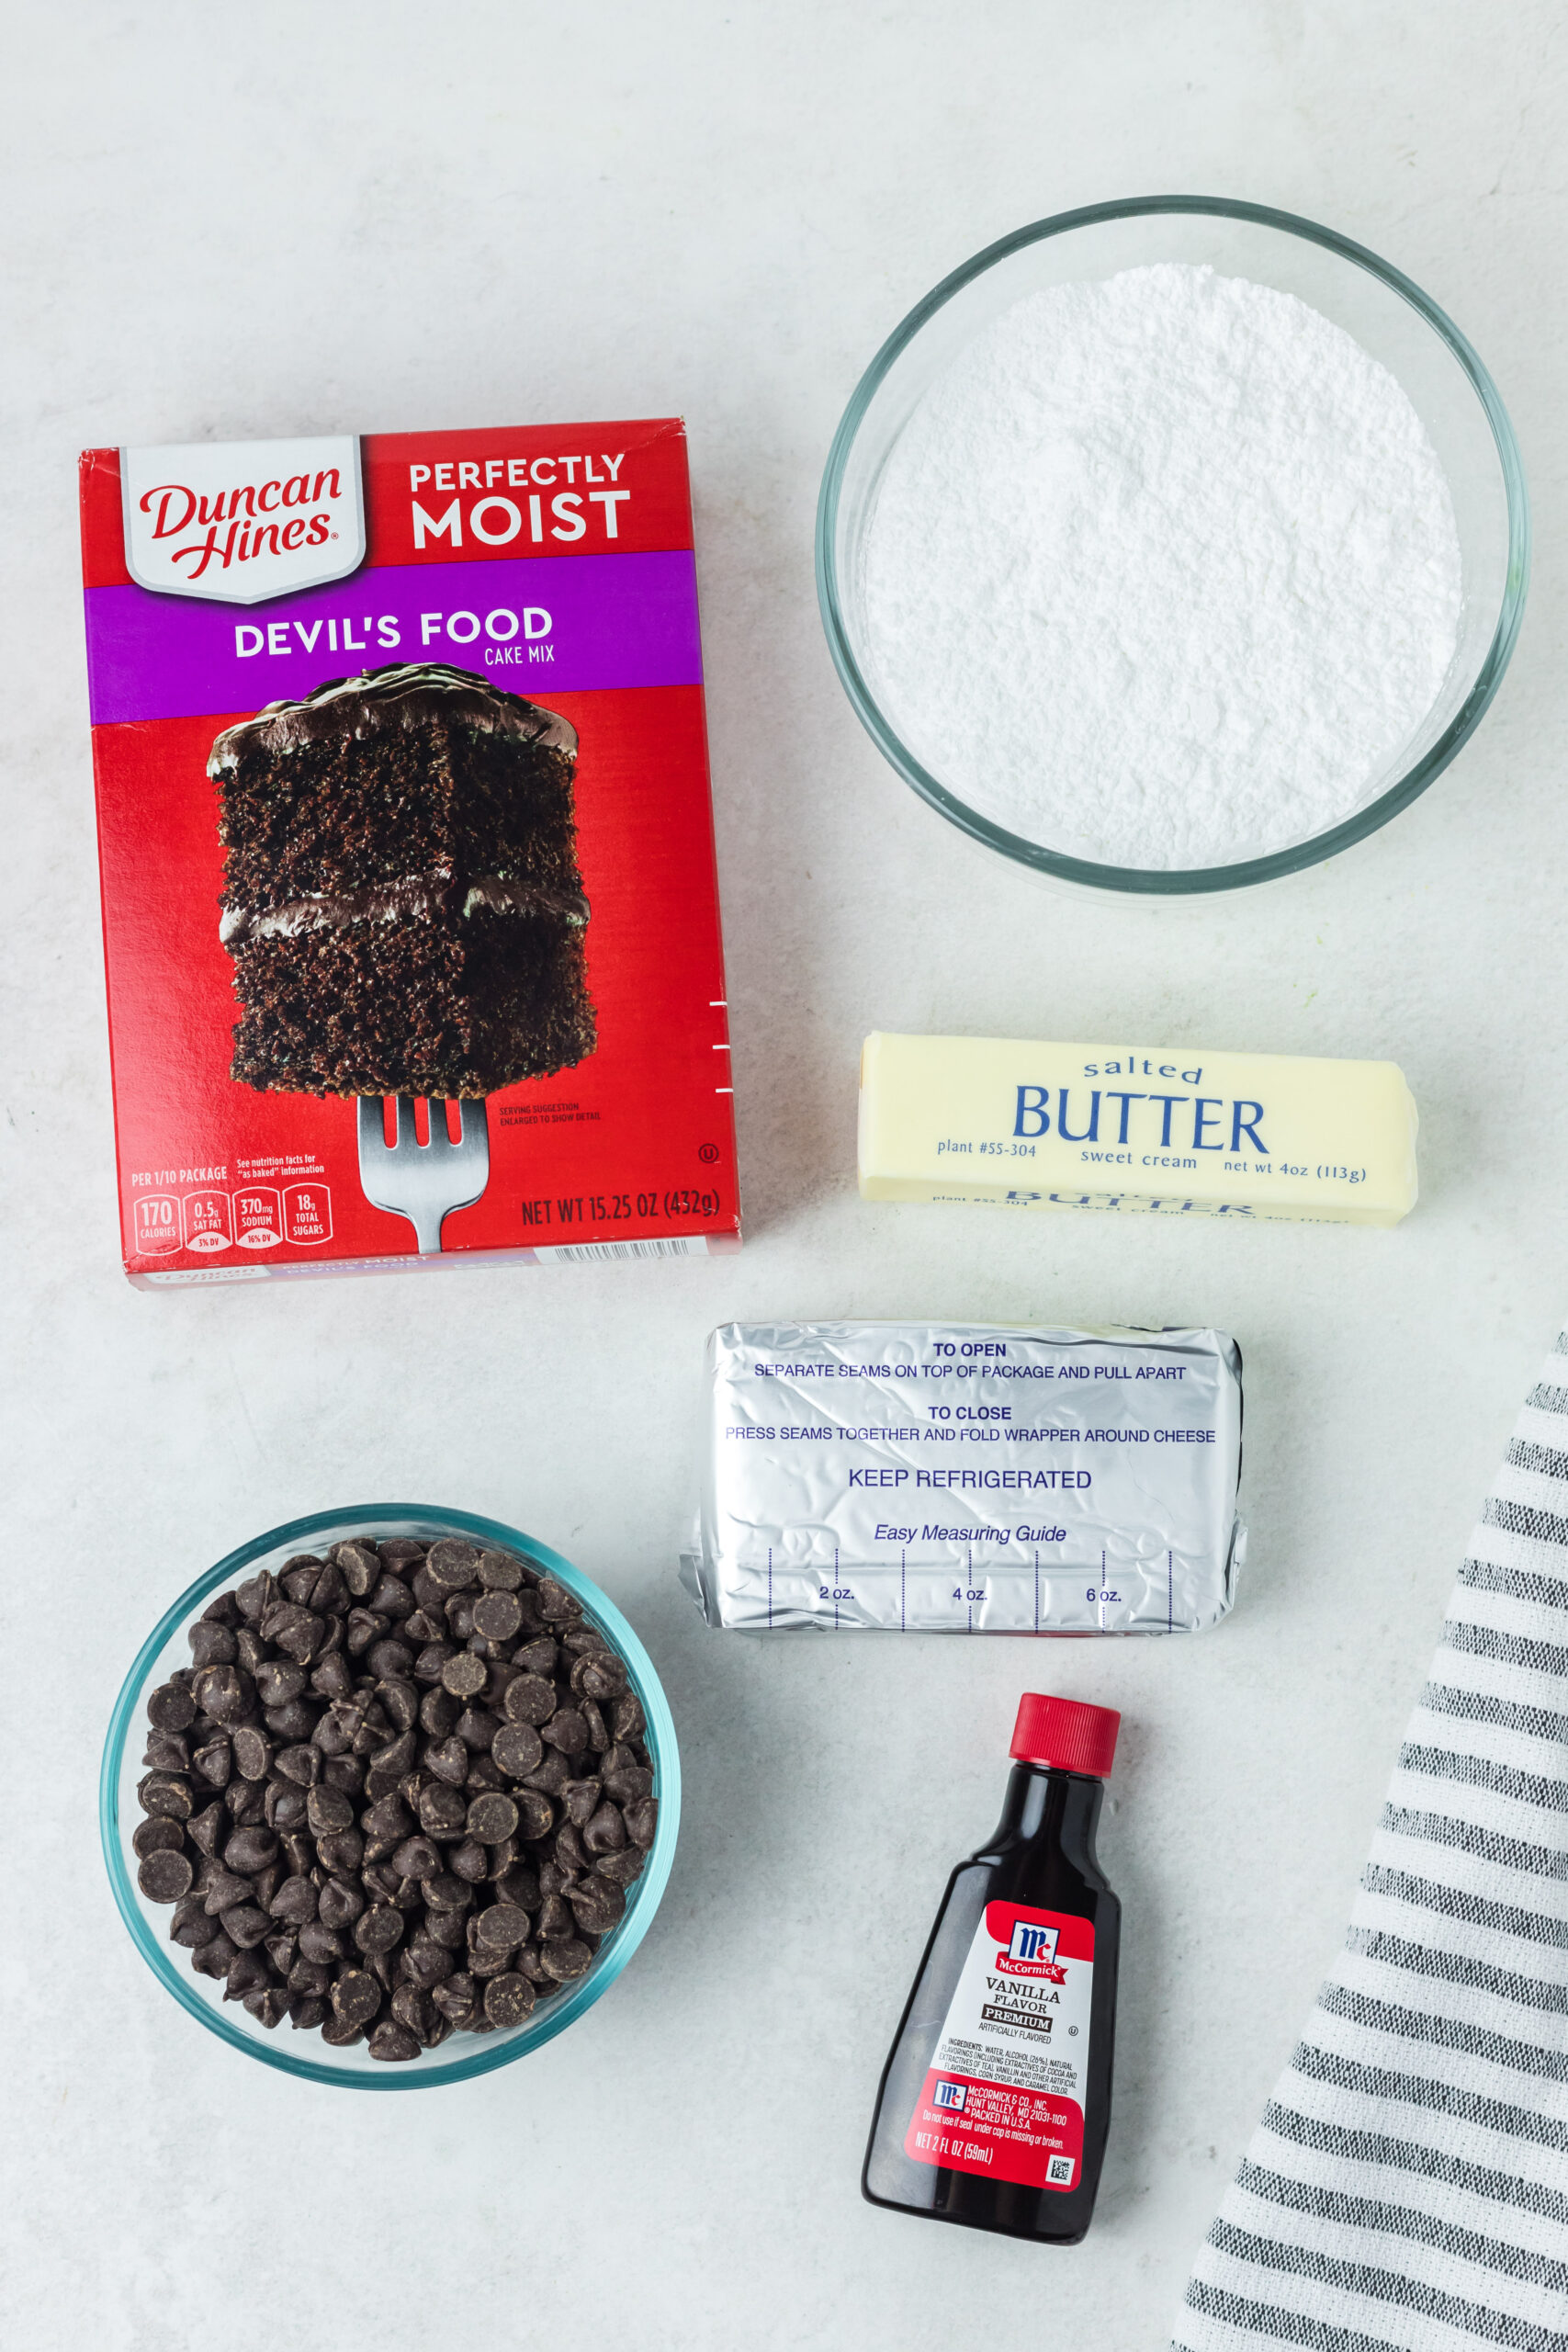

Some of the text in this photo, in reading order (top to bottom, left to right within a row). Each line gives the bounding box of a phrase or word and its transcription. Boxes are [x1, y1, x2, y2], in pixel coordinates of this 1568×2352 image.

[409, 453, 626, 492] PERFECTLY
[140, 467, 343, 540] Duncan
[412, 490, 631, 549] MOIST
[234, 606, 553, 658] DEVIL'S FOOD
[484, 644, 555, 665] CAKE MIX
[1084, 1057, 1203, 1086] salted
[500, 1102, 579, 1115] SERVING SUGGESTION
[501, 1112, 601, 1126] ENLARGED TO SHOW DETAIL
[1011, 1085, 1270, 1154] BUTTER
[938, 1139, 1036, 1158] plant #55-304
[236, 1154, 316, 1168] See nutrition facts for
[280, 1164, 325, 1176] information
[1080, 1150, 1198, 1170] sweet cream
[131, 1166, 227, 1186] PER 1/10 PACKAGE
[1224, 1161, 1366, 1183] net wt 4oz (113g)
[141, 1201, 173, 1225] 170
[194, 1202, 219, 1218] 0.5g
[297, 1194, 316, 1212] 18g
[522, 1189, 720, 1226] NET WT 15.25 OZ (432g)
[1006, 1191, 1255, 1215] BUTTER
[193, 1218, 222, 1230] SAT FAT
[242, 1216, 273, 1227] SODIUM
[295, 1213, 320, 1224] TOTAL
[141, 1227, 176, 1238] CALORIES
[247, 1233, 271, 1244] 16% DV
[293, 1224, 324, 1237] SUGARS
[198, 1238, 219, 1248] 3% DV
[366, 1255, 430, 1264] MOIST
[933, 1343, 1007, 1357] TO OPEN
[754, 1364, 1187, 1379] SEPARATE SEAMS ON TOP OF PACKAGE AND PULL APART
[928, 1407, 1011, 1419] TO CLOSE
[726, 1427, 1215, 1442] PRESS SEAMS TOGETHER AND FOLD WRAPPER AROUND CHEESE
[849, 1469, 1092, 1488] KEEP REFRIGERATED
[874, 1524, 1066, 1544] Easy Measuring Guide
[819, 1587, 855, 1600] 2 oz.
[953, 1588, 987, 1600] 4 oz.
[1086, 1589, 1122, 1602] 6 oz.
[986, 1976, 1061, 2005] VANILLA
[994, 1995, 1047, 2014] FLAVOR
[984, 2007, 1050, 2030] PREMIUM
[978, 2022, 1052, 2044] ARTIFICIALLY FLAVORED
[942, 2044, 973, 2058] FLAVORINGS
[1005, 2058, 1039, 2072] EXTRACTIVES
[1048, 2068, 1065, 2077] COCOA
[1066, 2071, 1077, 2079] AND
[948, 2038, 983, 2052] INGREDIENTS:
[985, 2046, 1004, 2057] WATER,
[1005, 2051, 1029, 2062] ALCOHOL
[1050, 2060, 1073, 2071] NATURAL
[939, 2052, 973, 2066] EXTRACTIVES
[974, 2060, 982, 2068] OF
[996, 2065, 1020, 2076] VANILLIN
[1020, 2071, 1032, 2079] AND
[1032, 2073, 1049, 2083] OTHER
[1050, 2077, 1077, 2088] ARTIFICIAL
[944, 2063, 977, 2076] FLAVORINGS,
[978, 2070, 993, 2079] CORN
[1013, 2077, 1025, 2086] AND
[1025, 2080, 1049, 2091] CARAMEL
[968, 2085, 1047, 2111] McCORMICK & CO., INC.
[965, 2096, 1067, 2126] HUNT VALLEY, MD 21031-1100
[970, 2108, 1032, 2131] PACKED IN U.S.A.
[923, 2109, 1064, 2149] Do not use if seal under cap is missing or broken.
[915, 2132, 994, 2165] NET 2 FL OZ (59mL)
